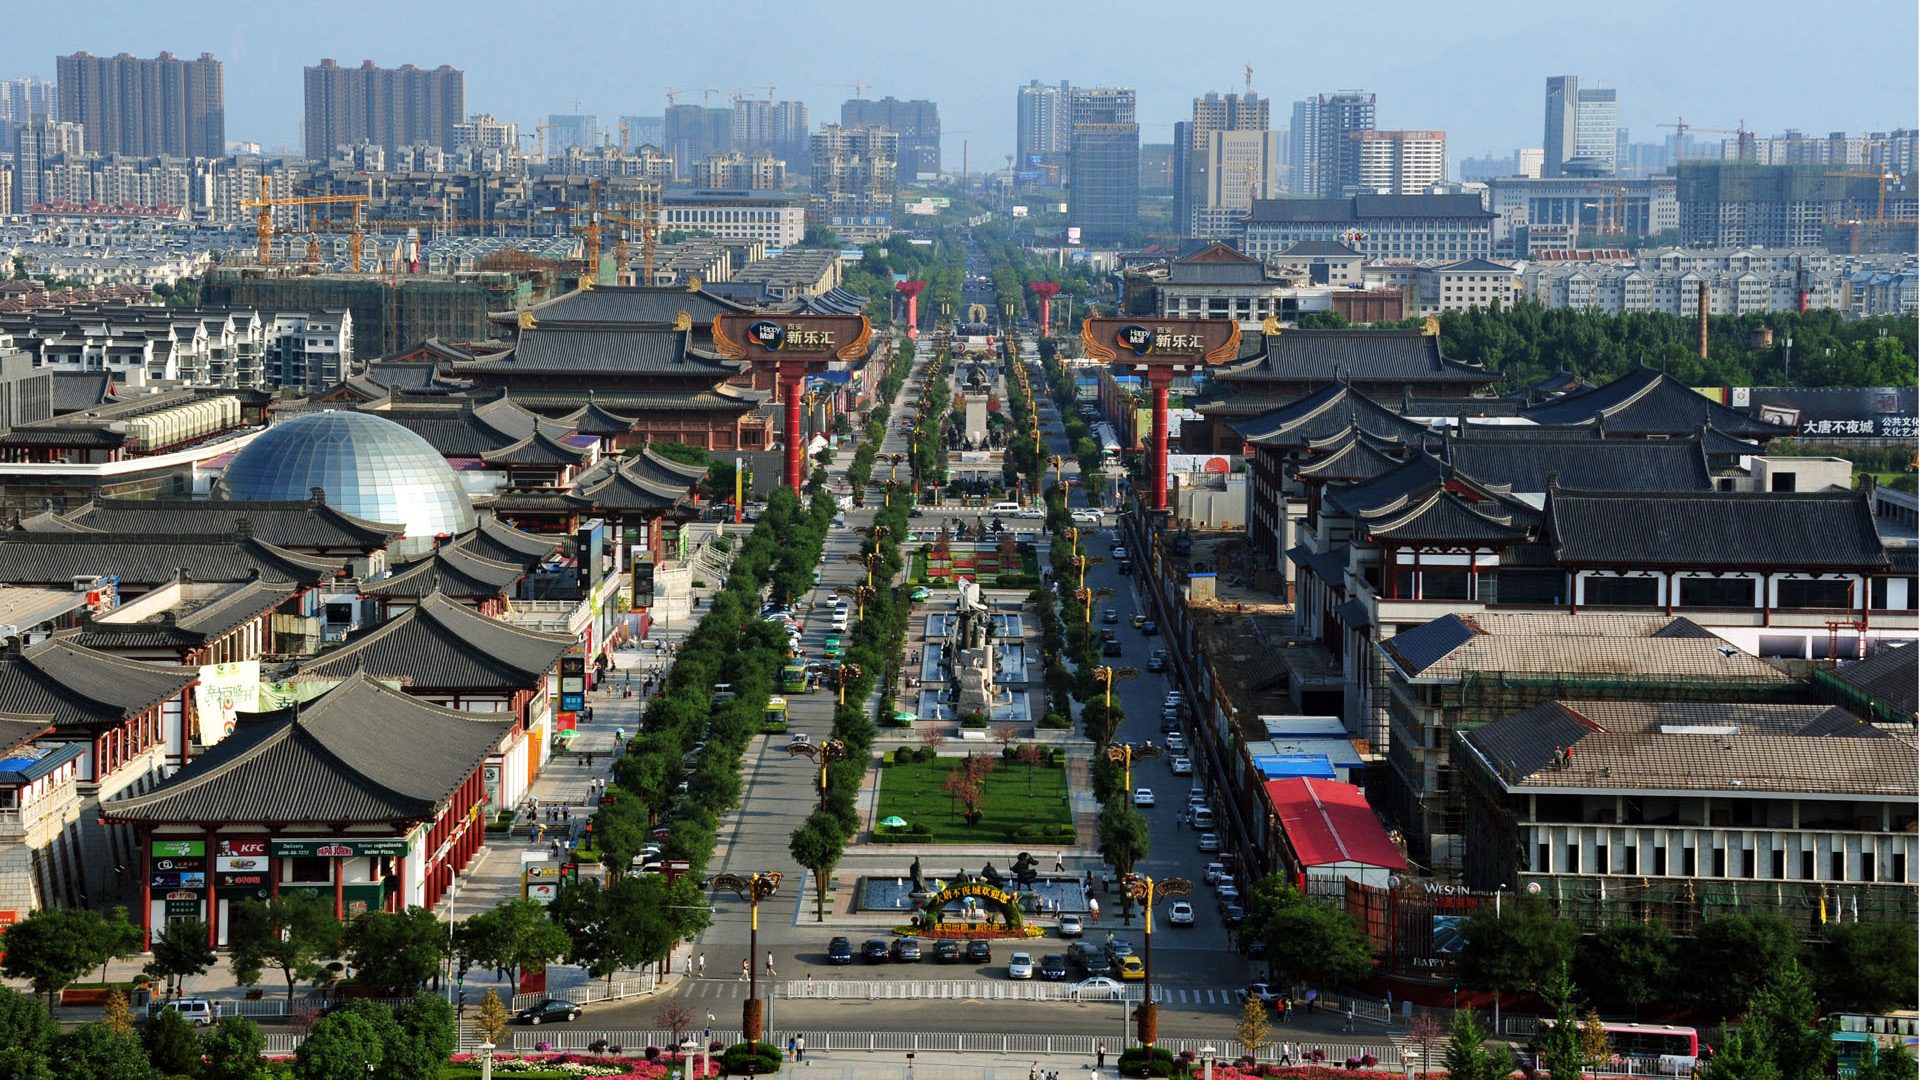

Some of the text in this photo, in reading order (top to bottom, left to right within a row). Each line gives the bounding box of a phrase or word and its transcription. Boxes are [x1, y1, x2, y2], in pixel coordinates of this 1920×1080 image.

[760, 325, 780, 334] Happy
[1130, 329, 1150, 338] Happy
[786, 331, 835, 344] 新乐汇
[1156, 334, 1204, 348] 新乐汇
[1803, 420, 1874, 434] 大唐不夜城
[1882, 417, 1918, 427] 公共文化
[1882, 428, 1918, 437] 文化艺术
[240, 844, 264, 852] KFC
[317, 846, 332, 856] PAPA
[1424, 883, 1470, 896] WESTIN
[1413, 957, 1446, 968] HAPPY
